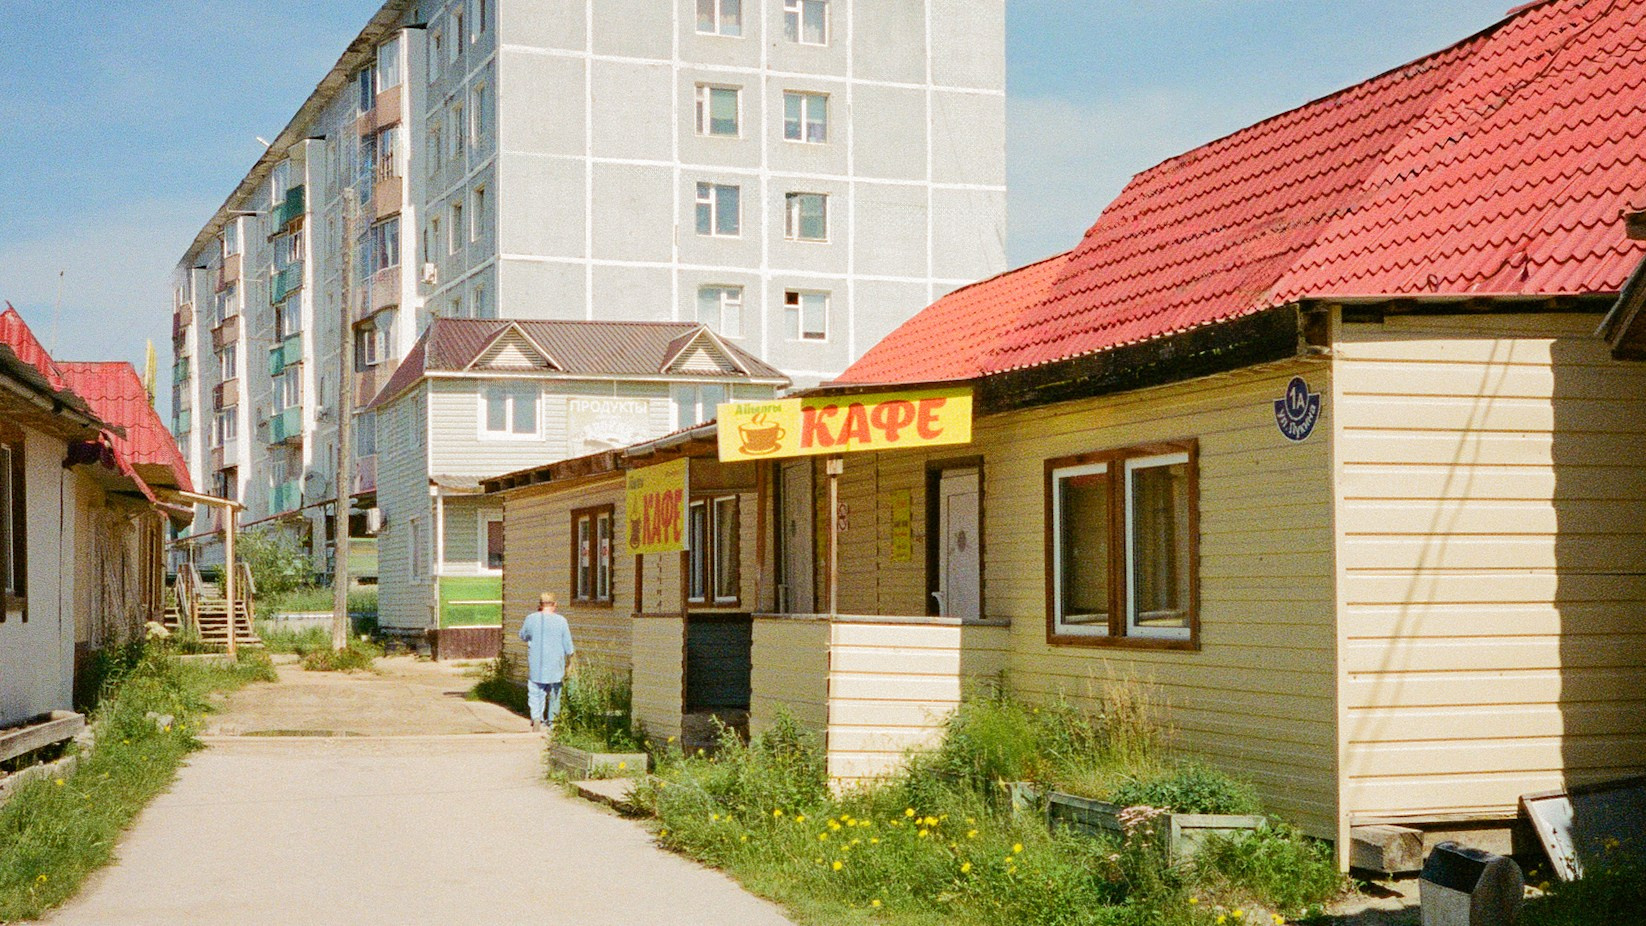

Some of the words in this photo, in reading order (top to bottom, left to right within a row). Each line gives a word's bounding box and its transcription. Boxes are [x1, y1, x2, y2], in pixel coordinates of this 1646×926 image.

[569, 399, 648, 413] ПРОДУКТЫ
[1290, 387, 1305, 409] 1А
[801, 397, 947, 449] КАФЕ
[643, 488, 683, 545] КАФЕ
